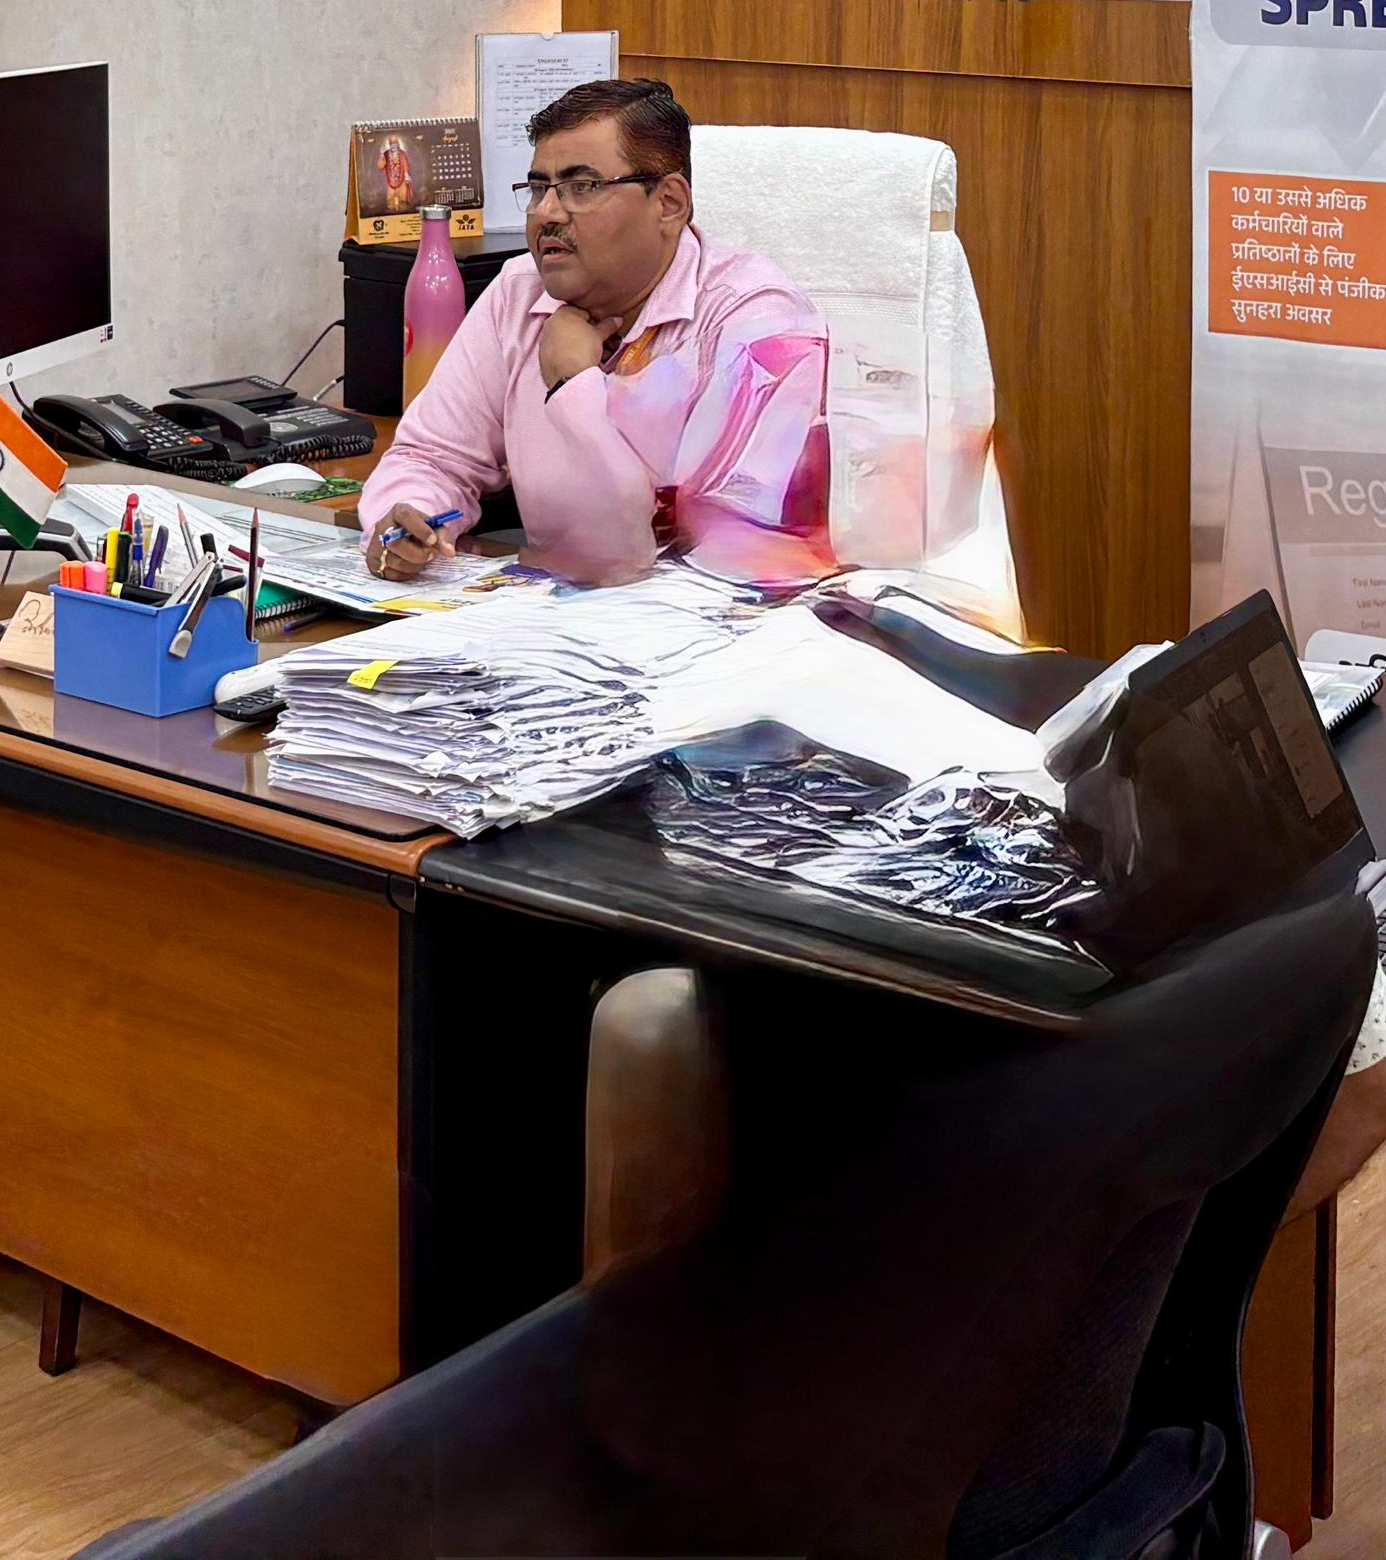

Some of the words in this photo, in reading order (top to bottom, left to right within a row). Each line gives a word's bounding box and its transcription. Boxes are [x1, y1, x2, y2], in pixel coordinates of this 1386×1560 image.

[1232, 187, 1248, 204] 10
[1253, 188, 1273, 205] या
[1277, 185, 1312, 209] उससे
[1316, 188, 1368, 212] अधिक
[1232, 209, 1307, 237] कर्मचारियों
[1312, 215, 1343, 239] वाले
[1232, 239, 1300, 267] प्रतिष्ठानों
[1304, 243, 1318, 266] के
[1322, 244, 1354, 269] लिए
[1232, 267, 1313, 298] ईएसआईसी
[1318, 273, 1333, 299] से
[1230, 298, 1282, 325] सुनहरा
[1286, 302, 1331, 325] अवसर
